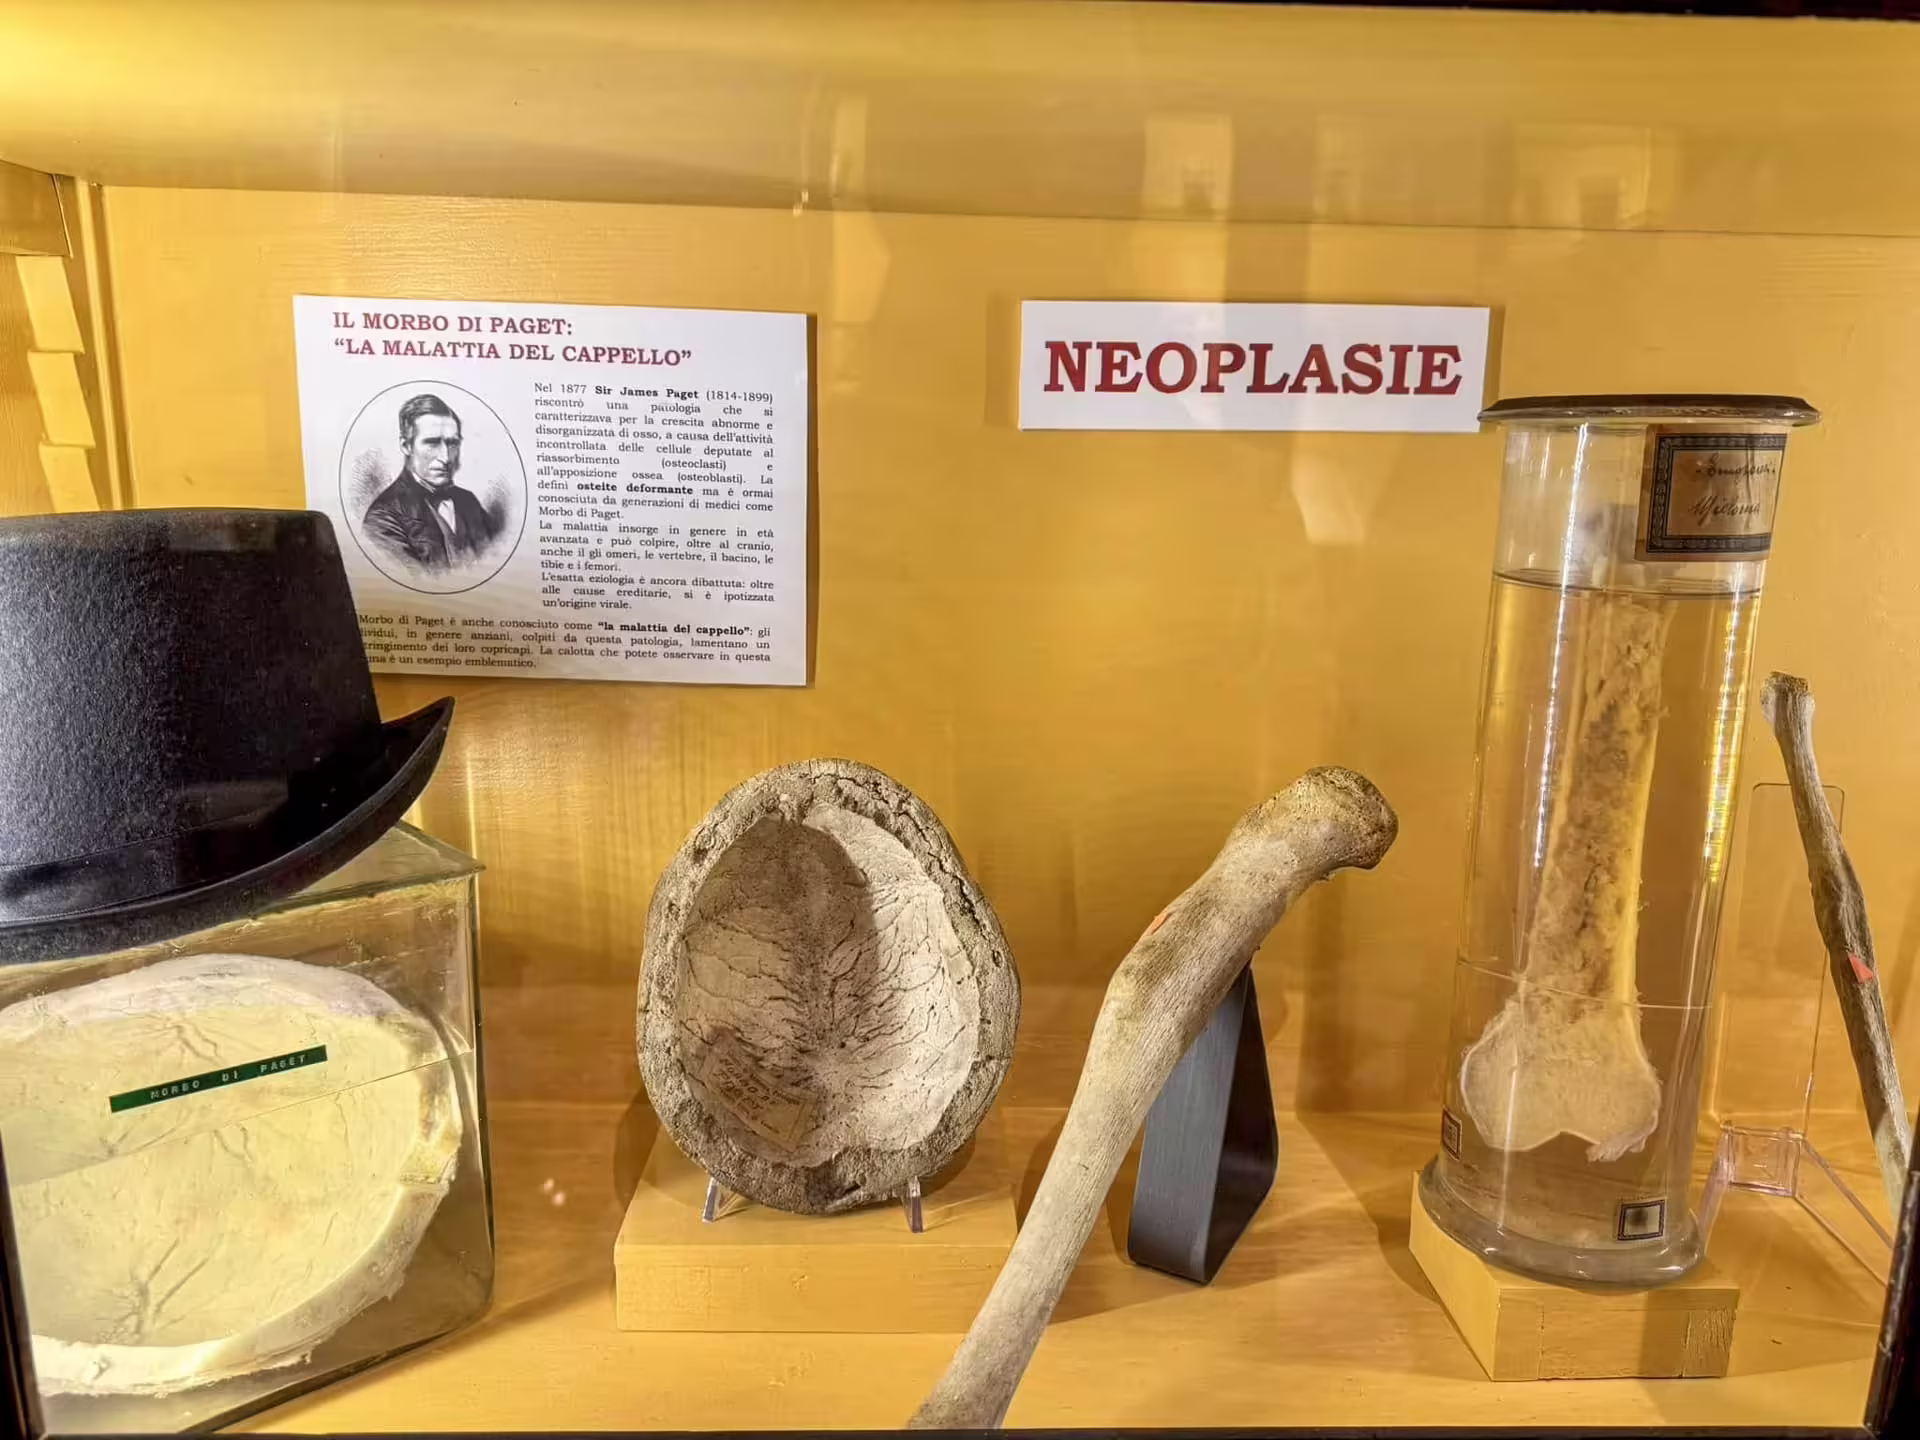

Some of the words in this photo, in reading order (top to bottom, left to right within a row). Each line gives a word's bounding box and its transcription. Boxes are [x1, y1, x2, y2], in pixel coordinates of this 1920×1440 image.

[333, 312, 355, 329] IL
[362, 313, 449, 331] MORBO
[457, 316, 483, 332] DI
[489, 317, 573, 335] PAGET:
[334, 338, 375, 356] “LA
[382, 340, 501, 359] MALATTIA
[508, 344, 555, 360] DEL
[561, 345, 691, 366] CAPPELLO”
[1043, 340, 1463, 395] NEOPLASIE
[534, 381, 552, 391] Nel
[561, 382, 586, 393] 1877
[594, 384, 612, 394] Sir
[619, 385, 658, 399] James
[665, 387, 698, 400] Paget
[706, 388, 773, 403] (1814-1899)
[534, 396, 584, 407] riscontrò
[650, 401, 701, 415] patologia
[722, 404, 742, 414] che
[763, 407, 773, 416] si
[534, 411, 612, 422] caratterizzava
[618, 416, 638, 426] per
[644, 414, 654, 424] la
[661, 416, 704, 426] crescita
[711, 418, 760, 429] abnorme
[534, 424, 616, 439] disorganizzata
[617, 427, 629, 437] di
[632, 431, 663, 440] osso,
[676, 432, 709, 440] causa
[535, 438, 606, 450] incontrollata
[617, 441, 644, 452] delle
[655, 443, 691, 454] cellule
[703, 445, 752, 459] deputate
[762, 447, 773, 457] al
[536, 452, 620, 464] riassorbimento
[660, 457, 726, 472] (osteoclasti)
[677, 471, 747, 485] (osteoblasti).
[760, 474, 773, 484] La
[537, 479, 568, 489] definì
[576, 481, 617, 491] osteite
[625, 482, 693, 494] deformante
[727, 486, 734, 496] è
[741, 488, 773, 497] ormai
[537, 493, 597, 504] conosciuta
[601, 495, 617, 504] da
[621, 496, 684, 510] generazioni
[688, 498, 699, 508] di
[704, 499, 740, 509] medici
[744, 503, 773, 511] come
[538, 505, 573, 516] Morbo
[575, 507, 587, 516] di
[590, 508, 624, 521] Paget.
[539, 519, 552, 529] La
[562, 520, 608, 531] malattia
[618, 523, 658, 536] insorge
[668, 525, 680, 534] in
[689, 528, 726, 539] genere
[736, 527, 747, 536] in
[756, 527, 774, 537] età
[539, 533, 589, 544] avanzata
[610, 535, 632, 548] può
[638, 536, 679, 550] colpire,
[685, 538, 711, 548] oltre
[718, 539, 729, 549] al
[736, 541, 774, 552] cranio,
[539, 546, 573, 556] anche
[577, 547, 585, 557] il
[588, 547, 602, 560] gli
[604, 549, 641, 560] omeri,
[644, 549, 654, 559] le
[657, 550, 706, 562] vertebre,
[709, 551, 717, 561] il
[721, 552, 761, 564] bacino,
[764, 553, 773, 563] le
[540, 558, 564, 568] tibie
[576, 561, 581, 569] i
[583, 560, 622, 571] femori.
[588, 573, 635, 587] eziologia
[638, 574, 645, 584] è
[649, 577, 688, 585] ancora
[691, 576, 746, 588] dibattuta:
[749, 578, 774, 589] oltre
[541, 584, 560, 594] alle
[572, 587, 605, 595] cause
[616, 586, 672, 599] ereditarie,
[683, 590, 693, 598] si
[704, 590, 711, 599] è
[723, 591, 774, 604] ipotizzata
[599, 598, 632, 609] virale.
[358, 613, 393, 624] Morbo
[150, 1079, 201, 1100] MORBO
[221, 1069, 239, 1083] DI
[260, 1054, 306, 1074] PAGET
